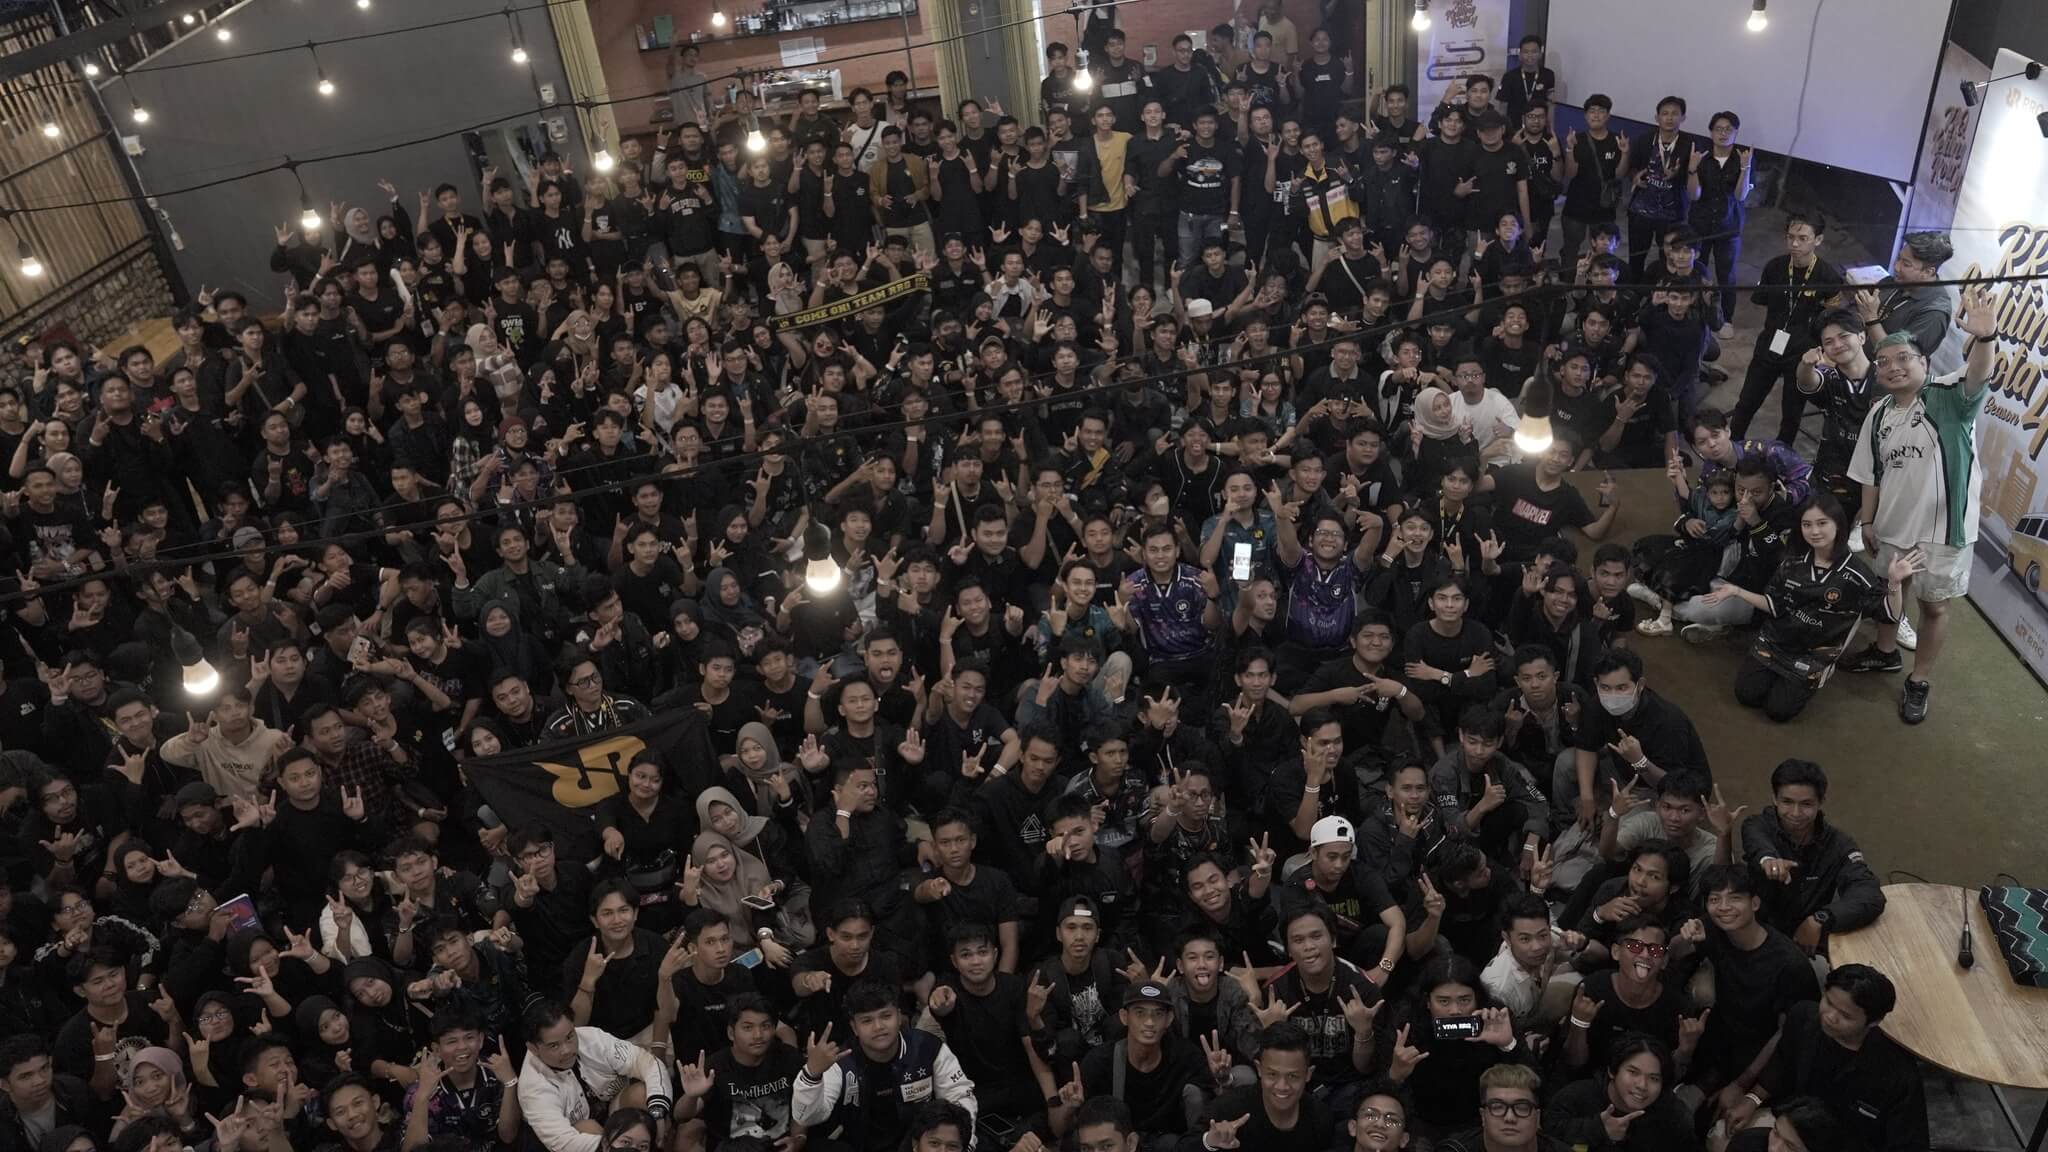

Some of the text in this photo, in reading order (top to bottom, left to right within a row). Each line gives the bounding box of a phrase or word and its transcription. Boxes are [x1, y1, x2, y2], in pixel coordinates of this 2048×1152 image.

[1997, 221, 2048, 289] RR
[795, 308, 828, 324] COME
[830, 302, 851, 318] ON!
[854, 291, 886, 307] TEAM
[1984, 396, 2020, 426] Season
[1513, 498, 1552, 525] MARVEL
